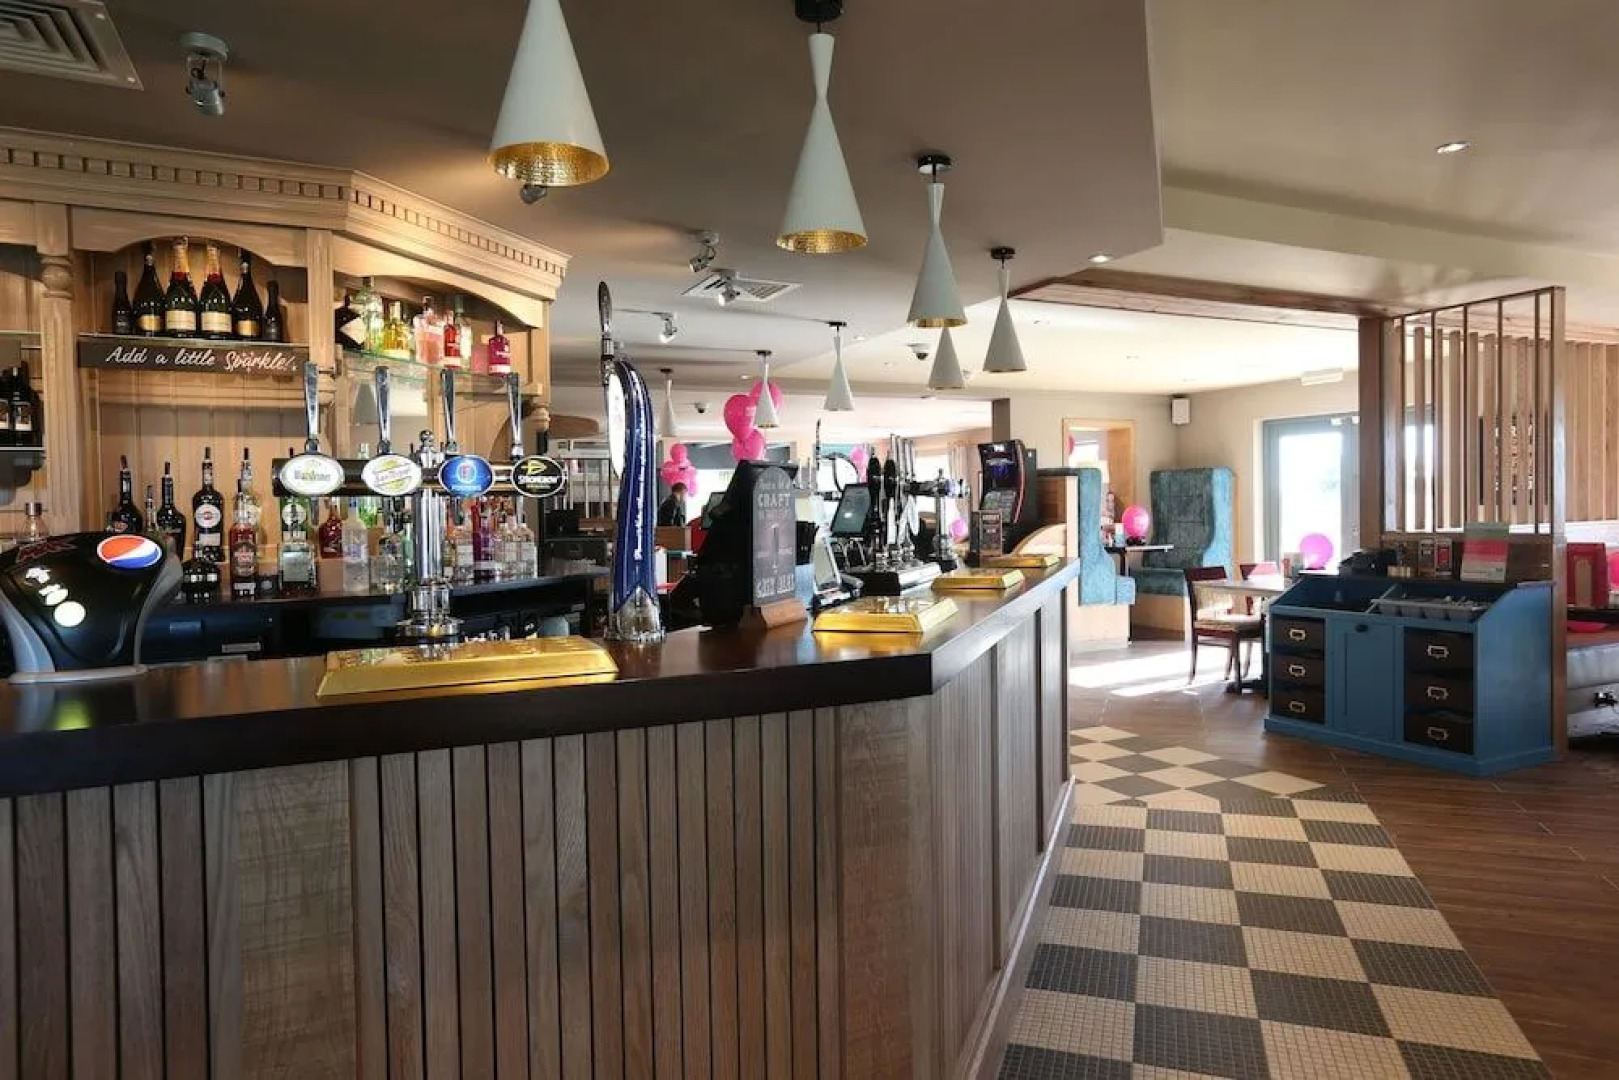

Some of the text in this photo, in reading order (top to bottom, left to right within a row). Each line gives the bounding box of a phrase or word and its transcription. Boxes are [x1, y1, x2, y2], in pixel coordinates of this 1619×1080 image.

[105, 346, 148, 364] Add
[155, 355, 169, 364] a
[175, 347, 216, 366] little
[757, 493, 790, 507] CRAFT
